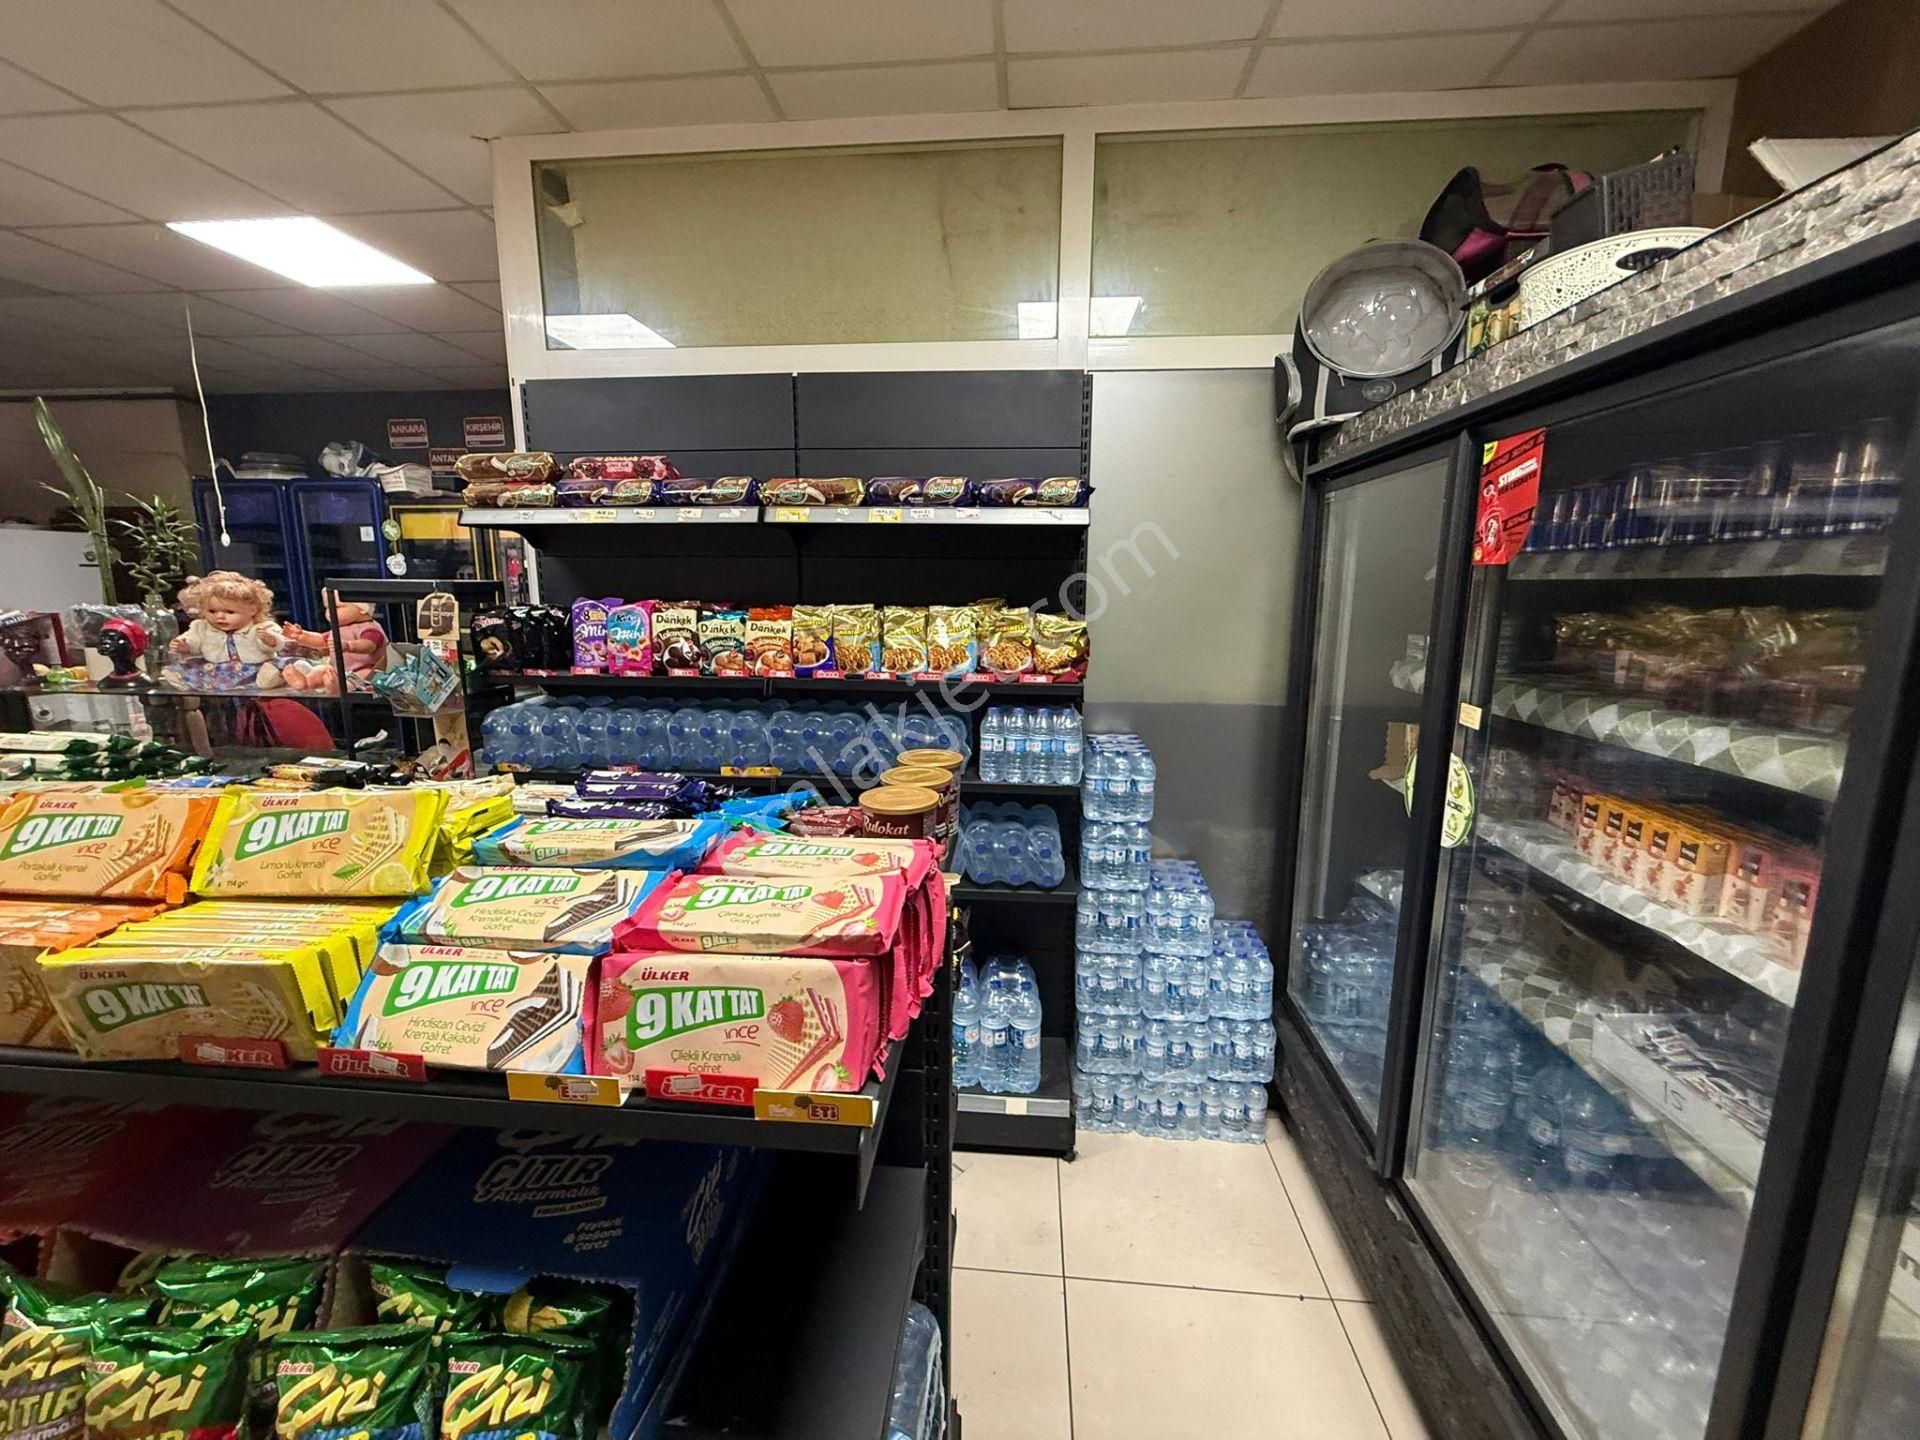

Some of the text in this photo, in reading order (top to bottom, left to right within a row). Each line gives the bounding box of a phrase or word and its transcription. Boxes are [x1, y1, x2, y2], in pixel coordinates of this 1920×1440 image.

[391, 424, 426, 434] ANKARA
[466, 422, 502, 433] KIRŞEHİR
[431, 454, 459, 463] ANTAL
[750, 623, 788, 635] Dankek
[39, 800, 78, 809] ÜLKER
[262, 796, 299, 807] ÜLKER
[244, 810, 347, 852] 9 KAT TAT
[863, 815, 910, 835] Rulokat
[11, 815, 121, 853] 9 KAT TAT
[312, 837, 342, 850] ince
[755, 842, 853, 856] 9 KAT TAT
[463, 876, 577, 902] 9 KAT TAT
[694, 886, 810, 909] 9 KAT TAT
[79, 968, 128, 980] ÜLKER
[641, 967, 690, 981] ÜLKER
[394, 964, 516, 1008] 9 KAT TAT
[86, 983, 205, 1026] 9 KAT TAT
[470, 998, 505, 1013] ince
[636, 989, 760, 1041] 9 KAT TAT
[408, 1016, 488, 1032] Hindistan Cevizli
[439, 1030, 482, 1045] Kakaolu
[724, 1025, 760, 1040] ince
[198, 1043, 274, 1066] KER
[420, 1041, 454, 1055] Gofret
[671, 1049, 742, 1063] Çilekli Kremalı
[688, 1062, 723, 1074] Gofret
[85, 1362, 208, 1431] Çizi
[276, 1363, 387, 1440] Çizi
[441, 1363, 554, 1440] Çizi
